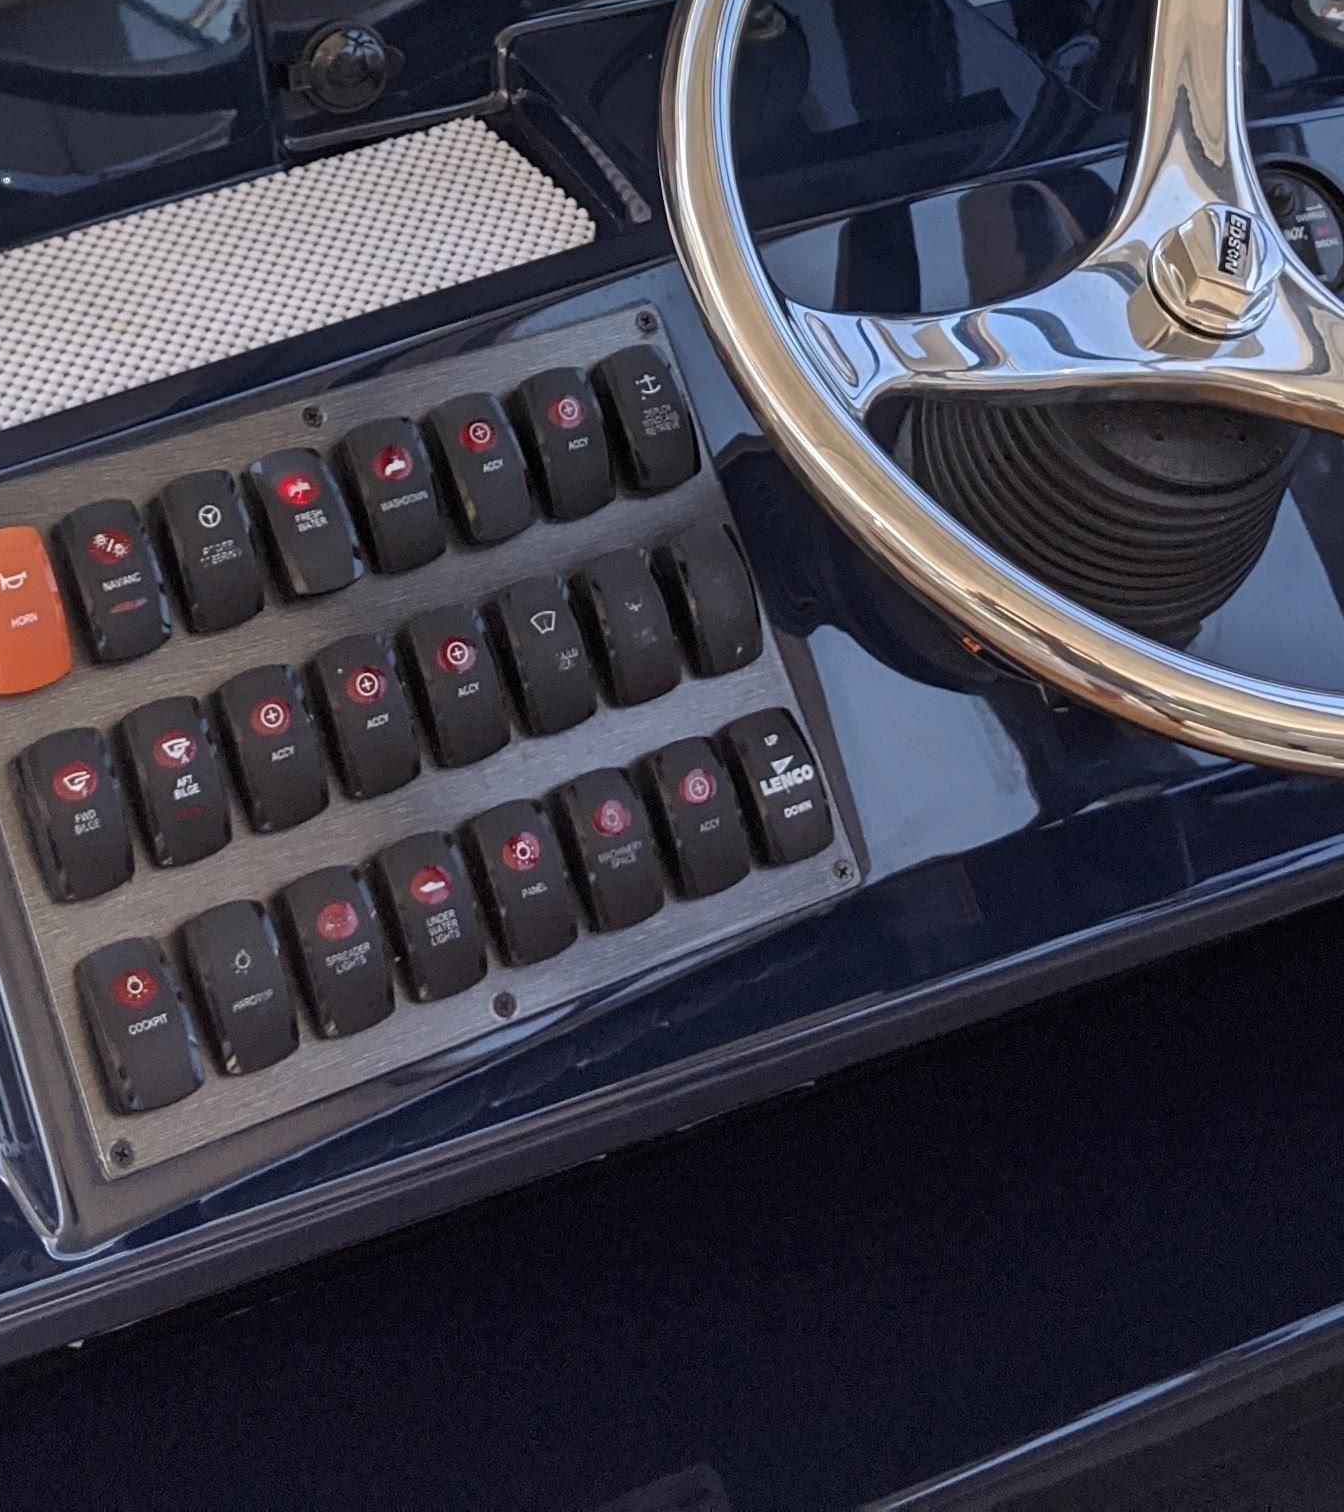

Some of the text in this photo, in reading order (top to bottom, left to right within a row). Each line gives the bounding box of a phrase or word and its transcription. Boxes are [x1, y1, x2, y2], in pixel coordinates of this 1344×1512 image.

[1223, 213, 1249, 275] EDSON
[567, 436, 589, 451] ACCY
[482, 458, 505, 474] ACCY
[294, 508, 324, 523] FRESH
[296, 516, 329, 533] WATER
[10, 612, 39, 628] HORN
[457, 682, 480, 698] ACCY
[366, 713, 390, 730] ACCY
[763, 734, 779, 747] UP
[271, 745, 295, 762] ACCY
[175, 774, 194, 789] AFT
[759, 763, 815, 797] LENCO
[173, 782, 201, 801] BILGE
[74, 809, 97, 824] FWD
[784, 799, 814, 819] DOWN
[74, 818, 102, 835] BILGE
[699, 816, 721, 833] ACCY
[425, 908, 457, 927] UNDER
[428, 919, 459, 937] WATER
[430, 927, 462, 947] LIGHTS
[325, 941, 372, 967] SPREADER
[335, 954, 368, 975] LIGHTS
[128, 1012, 169, 1036] COCKPIT
